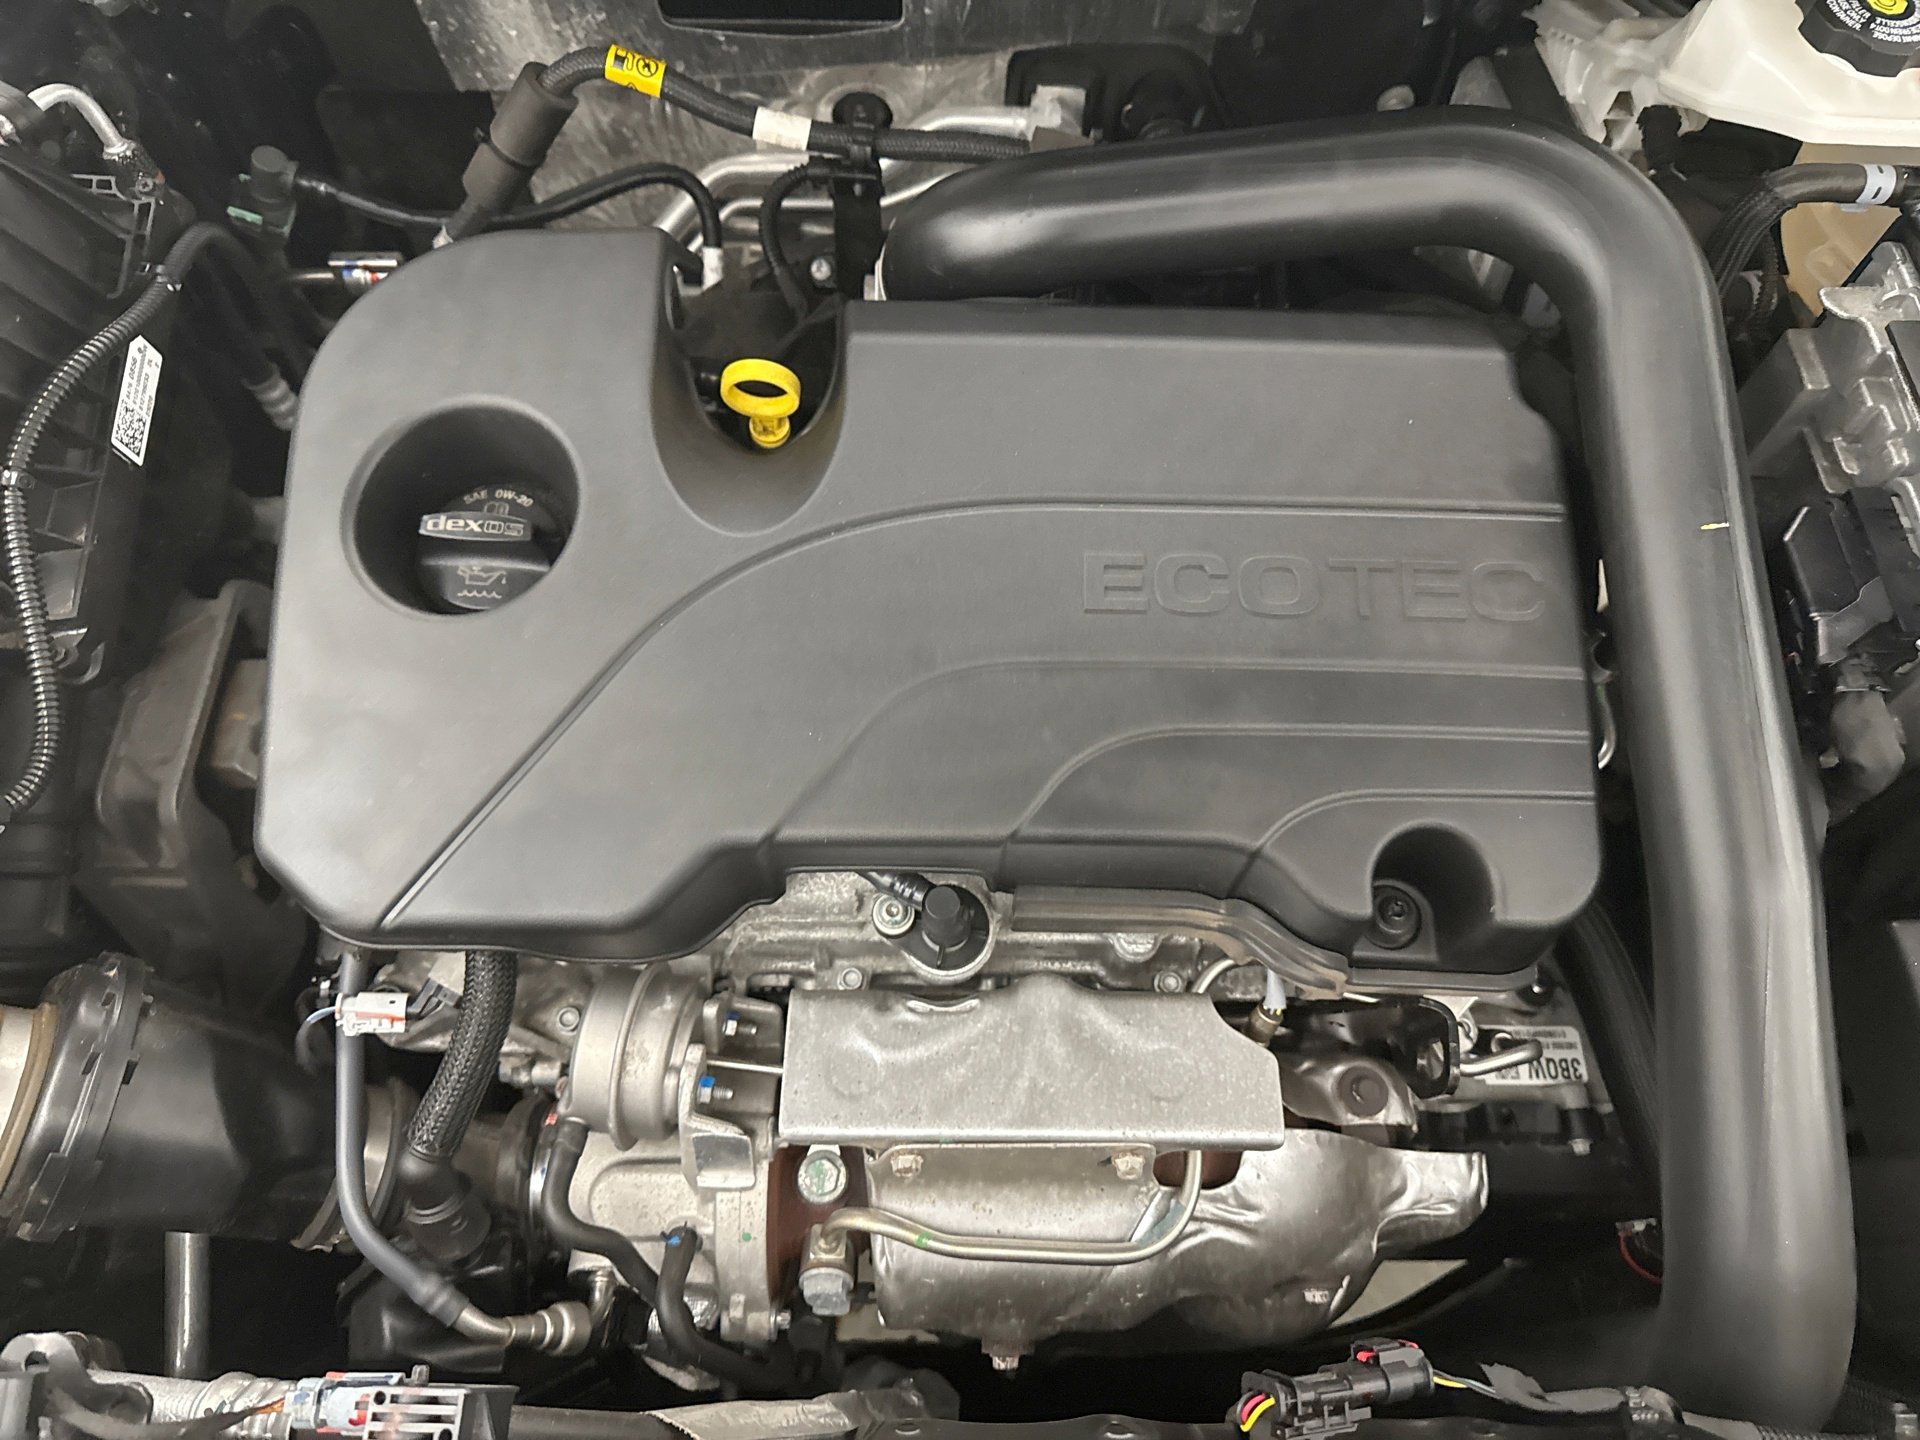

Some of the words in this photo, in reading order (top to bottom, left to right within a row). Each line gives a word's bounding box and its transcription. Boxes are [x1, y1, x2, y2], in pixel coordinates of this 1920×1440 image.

[1875, 25, 1890, 34] DOT
[463, 488, 489, 505] SAE
[495, 488, 534, 508] 0W-20
[426, 514, 525, 537] dexos
[1083, 550, 1547, 624] ECOTEC
